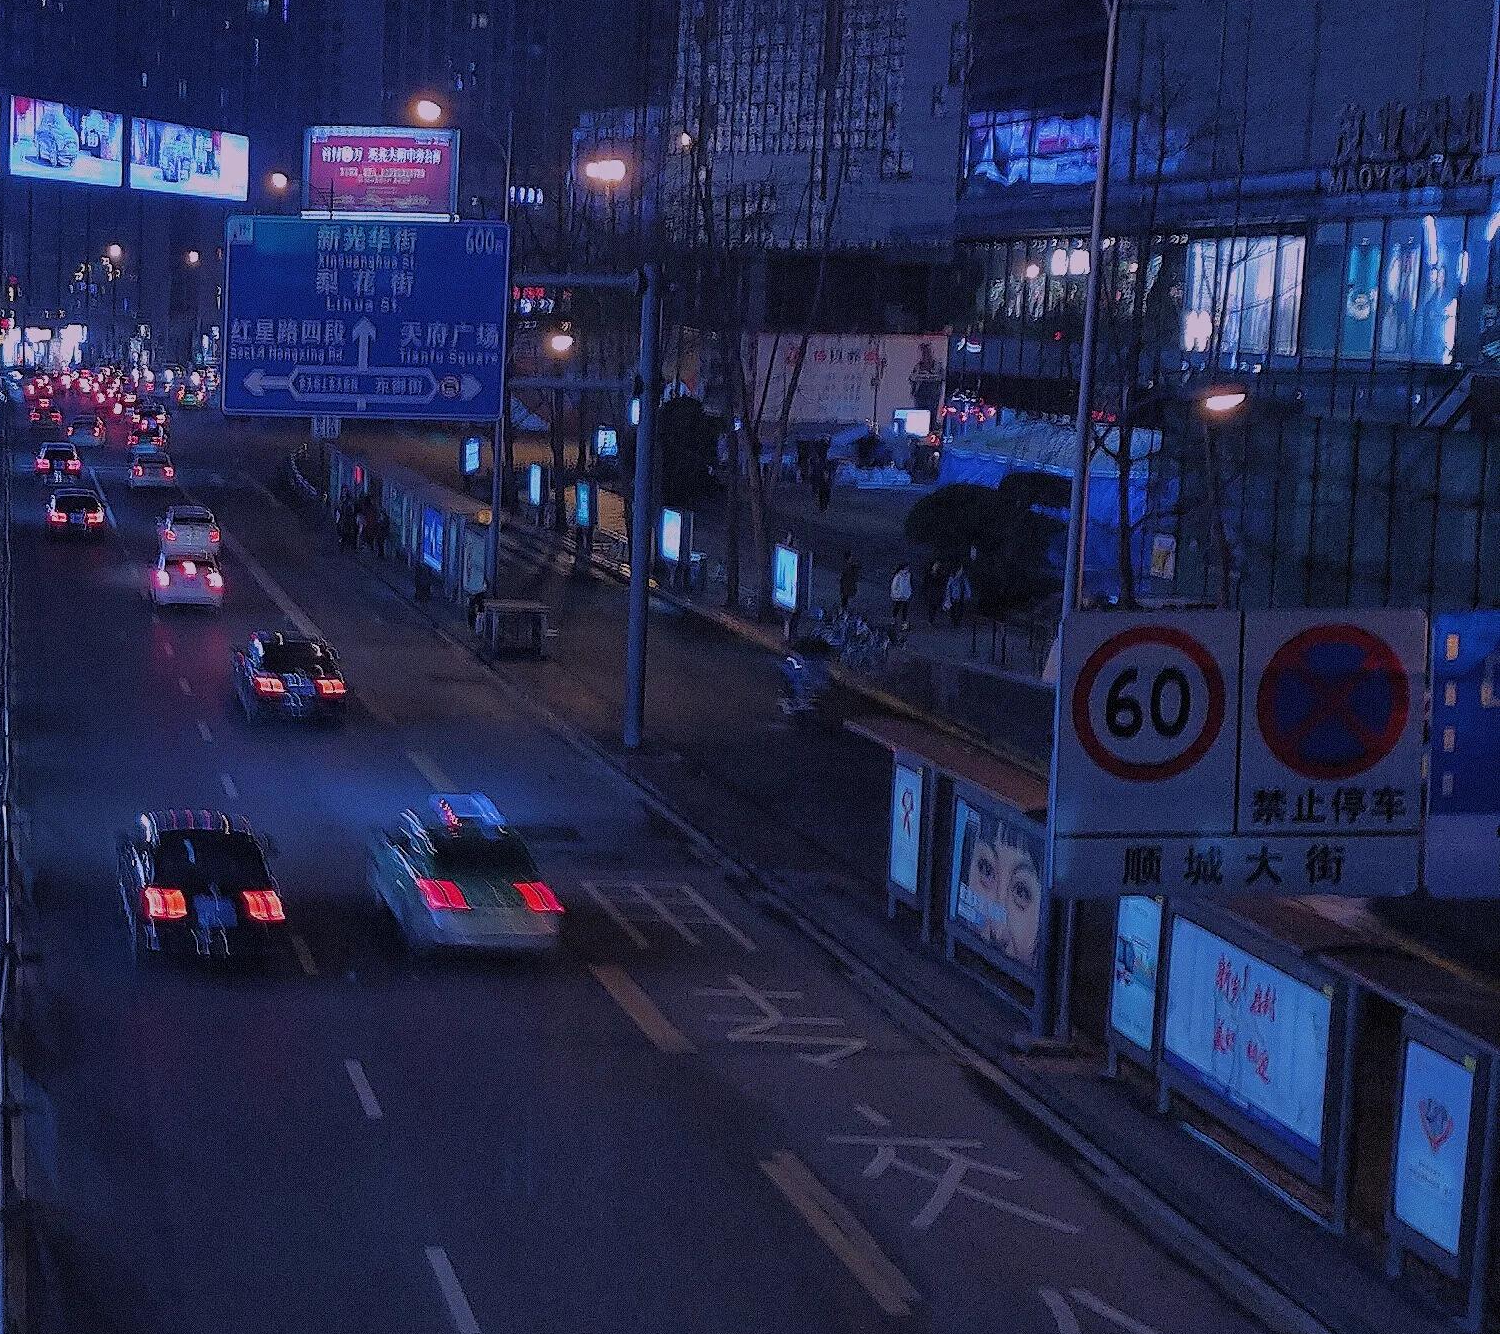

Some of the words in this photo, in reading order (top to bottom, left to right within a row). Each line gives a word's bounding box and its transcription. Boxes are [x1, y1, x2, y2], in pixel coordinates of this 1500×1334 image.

[316, 225, 418, 255] 新光华街
[315, 269, 415, 298] 梨花街
[326, 296, 375, 312] Lihua
[230, 317, 346, 346] 红星路四段
[400, 320, 500, 349] 天府广场
[399, 348, 444, 365] Tianfu
[448, 348, 499, 367] Square
[1105, 668, 1192, 738] 60
[1251, 786, 1406, 825] 禁止停车
[1123, 845, 1346, 886] 顺城大街
